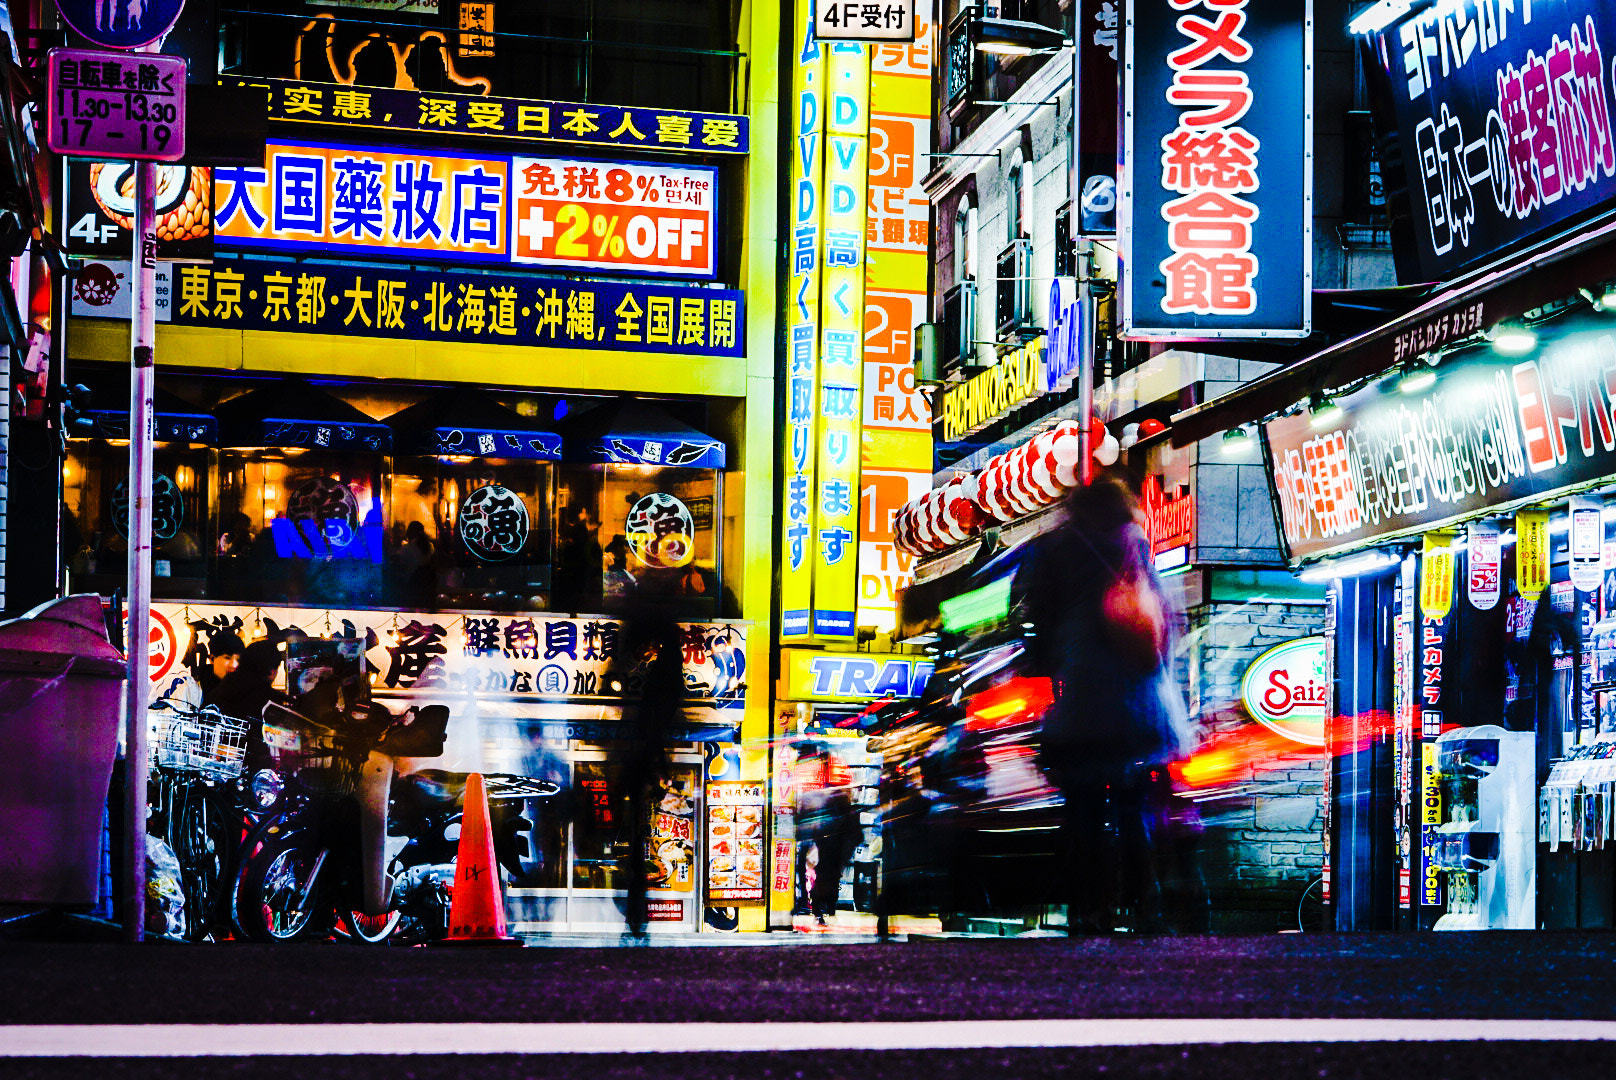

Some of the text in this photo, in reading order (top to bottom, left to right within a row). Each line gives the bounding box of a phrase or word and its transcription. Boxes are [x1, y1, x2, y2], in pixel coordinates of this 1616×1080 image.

[823, 3, 906, 30] 4F受付
[1400, 0, 1532, 101] ヨドバシカ
[59, 58, 174, 92] 自転車を除く
[57, 88, 176, 123] 11.30-13.30
[266, 83, 740, 147] 实惠，深受日本人喜爱
[61, 118, 92, 146] 17
[140, 123, 171, 151] 19
[1416, 15, 1616, 256] 日本一の接客応対
[1161, 0, 1260, 315] メラ総合館
[521, 162, 660, 203] 免税8%
[659, 174, 709, 190] Tax-Free
[665, 189, 702, 206] 면세
[69, 213, 119, 244] 4F
[819, 43, 865, 565] ・DVD高く買取ります
[865, 304, 909, 355] 2F
[861, 574, 913, 606] DV
[1471, 569, 1497, 589] 5%
[777, 710, 796, 806] ゲーム・DV
